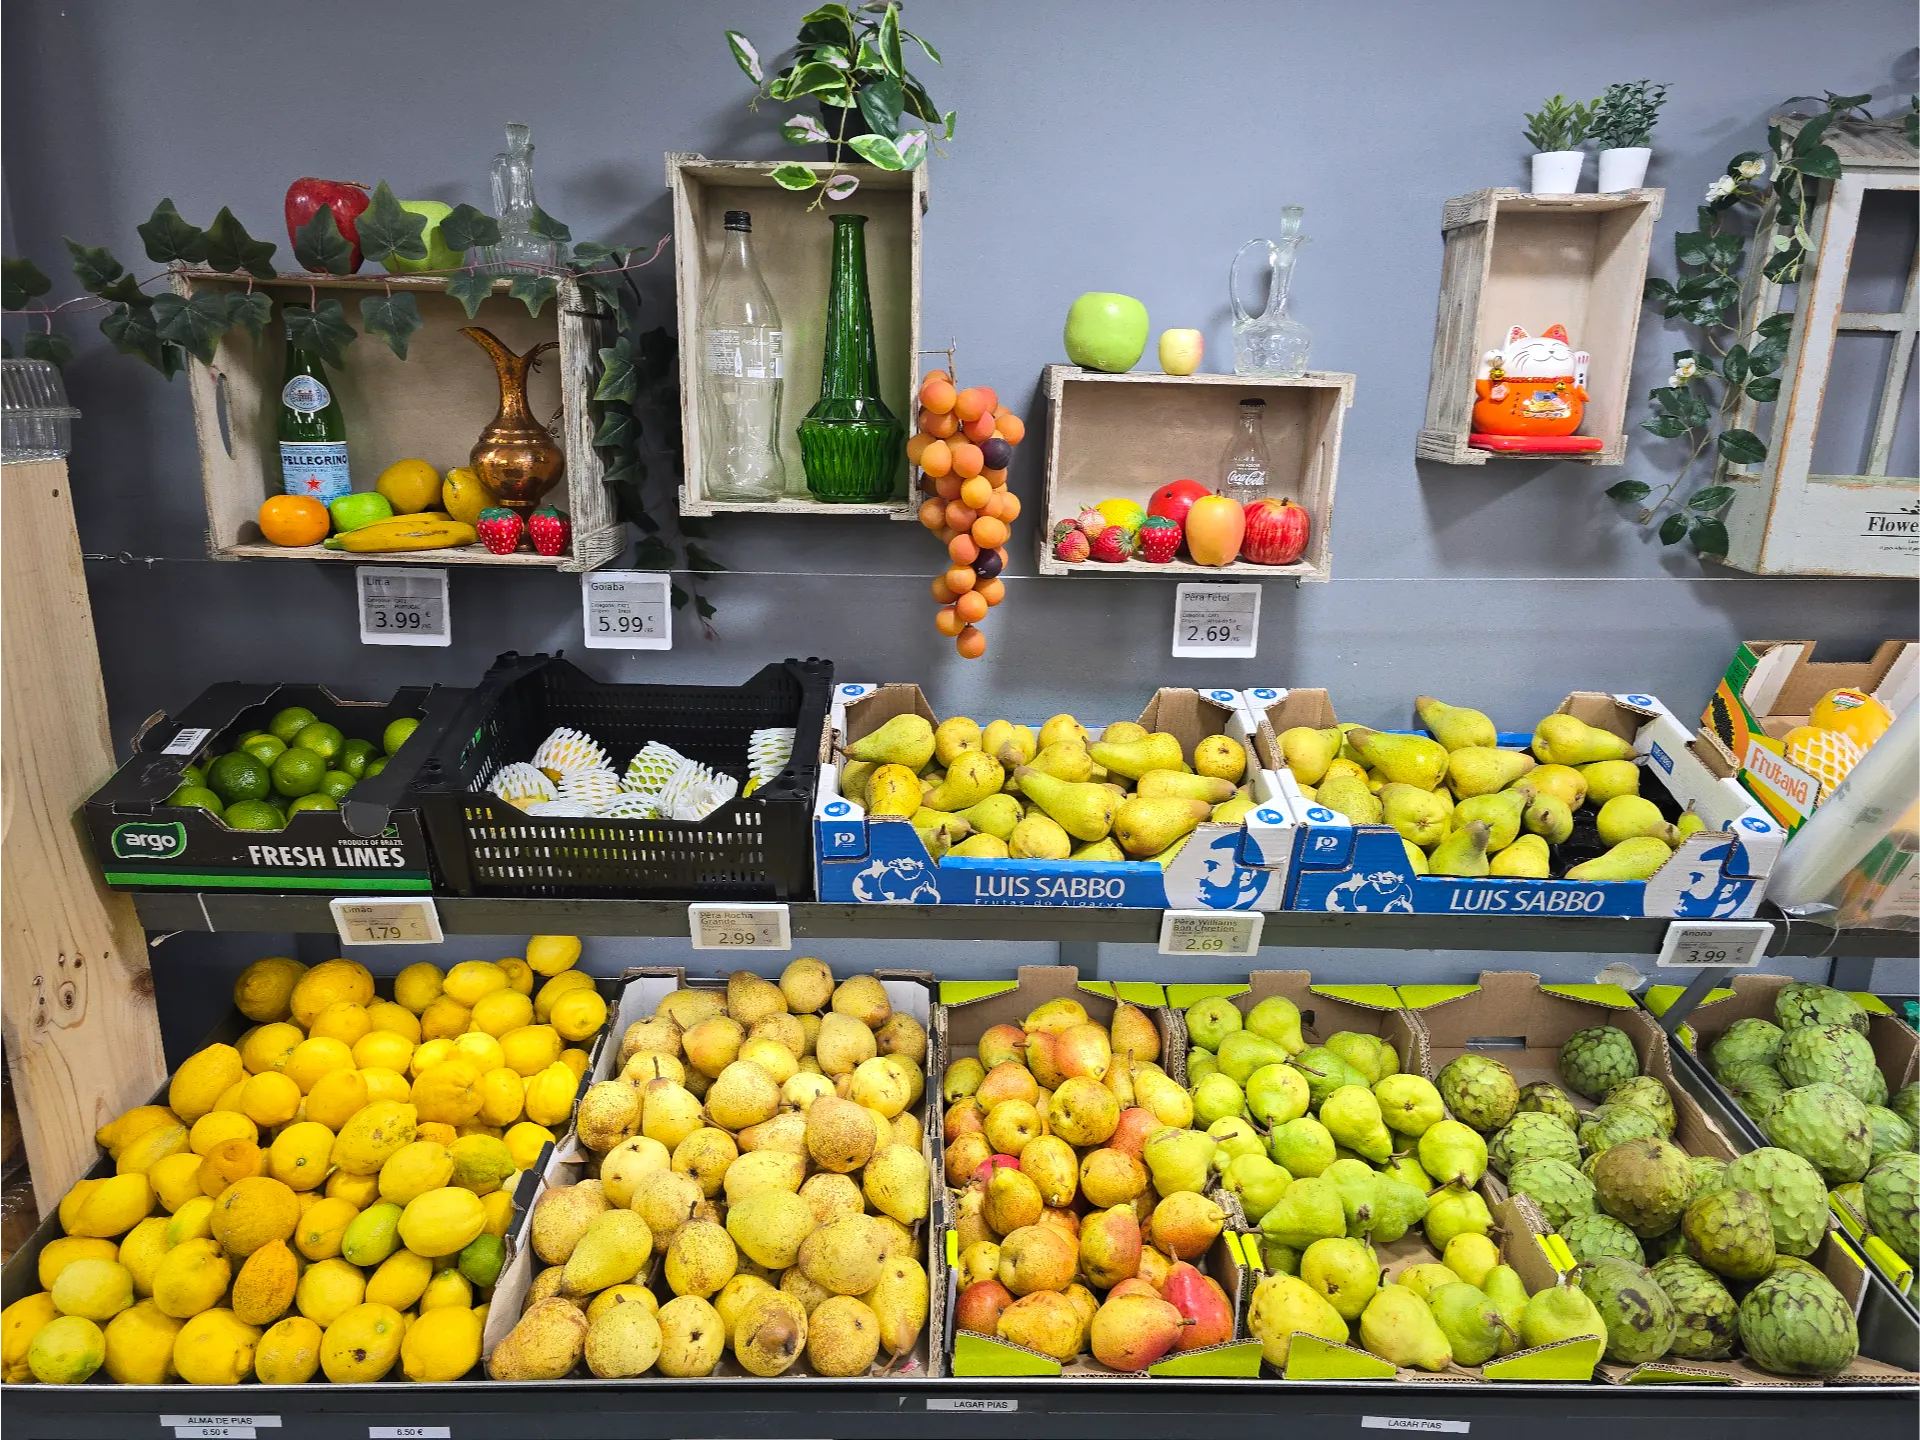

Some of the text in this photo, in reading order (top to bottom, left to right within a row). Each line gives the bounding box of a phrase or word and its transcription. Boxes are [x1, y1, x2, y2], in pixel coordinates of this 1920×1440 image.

[591, 582, 625, 591] Goiaba
[375, 611, 420, 629] 3.99
[599, 616, 644, 633] 5.99
[1187, 625, 1231, 642] 2.69
[123, 833, 177, 851] argo
[248, 845, 406, 868] FRESH LIMES
[975, 875, 1126, 899] LUIS SABBO
[974, 898, 1025, 906] Frutas
[1449, 888, 1606, 912] LUIS SABBO
[343, 906, 373, 914] Limão
[701, 911, 754, 919] Pêra Rocha
[1198, 919, 1238, 927] Williams
[366, 926, 402, 939] 1.79
[719, 932, 756, 945] 2.99
[1185, 938, 1224, 951] 2.69
[1686, 950, 1727, 963] 3.99
[231, 1417, 253, 1425] PIAS
[1421, 1421, 1443, 1429] PIAS
[202, 1428, 221, 1436] 6.50
[396, 1428, 416, 1436] 6.50
